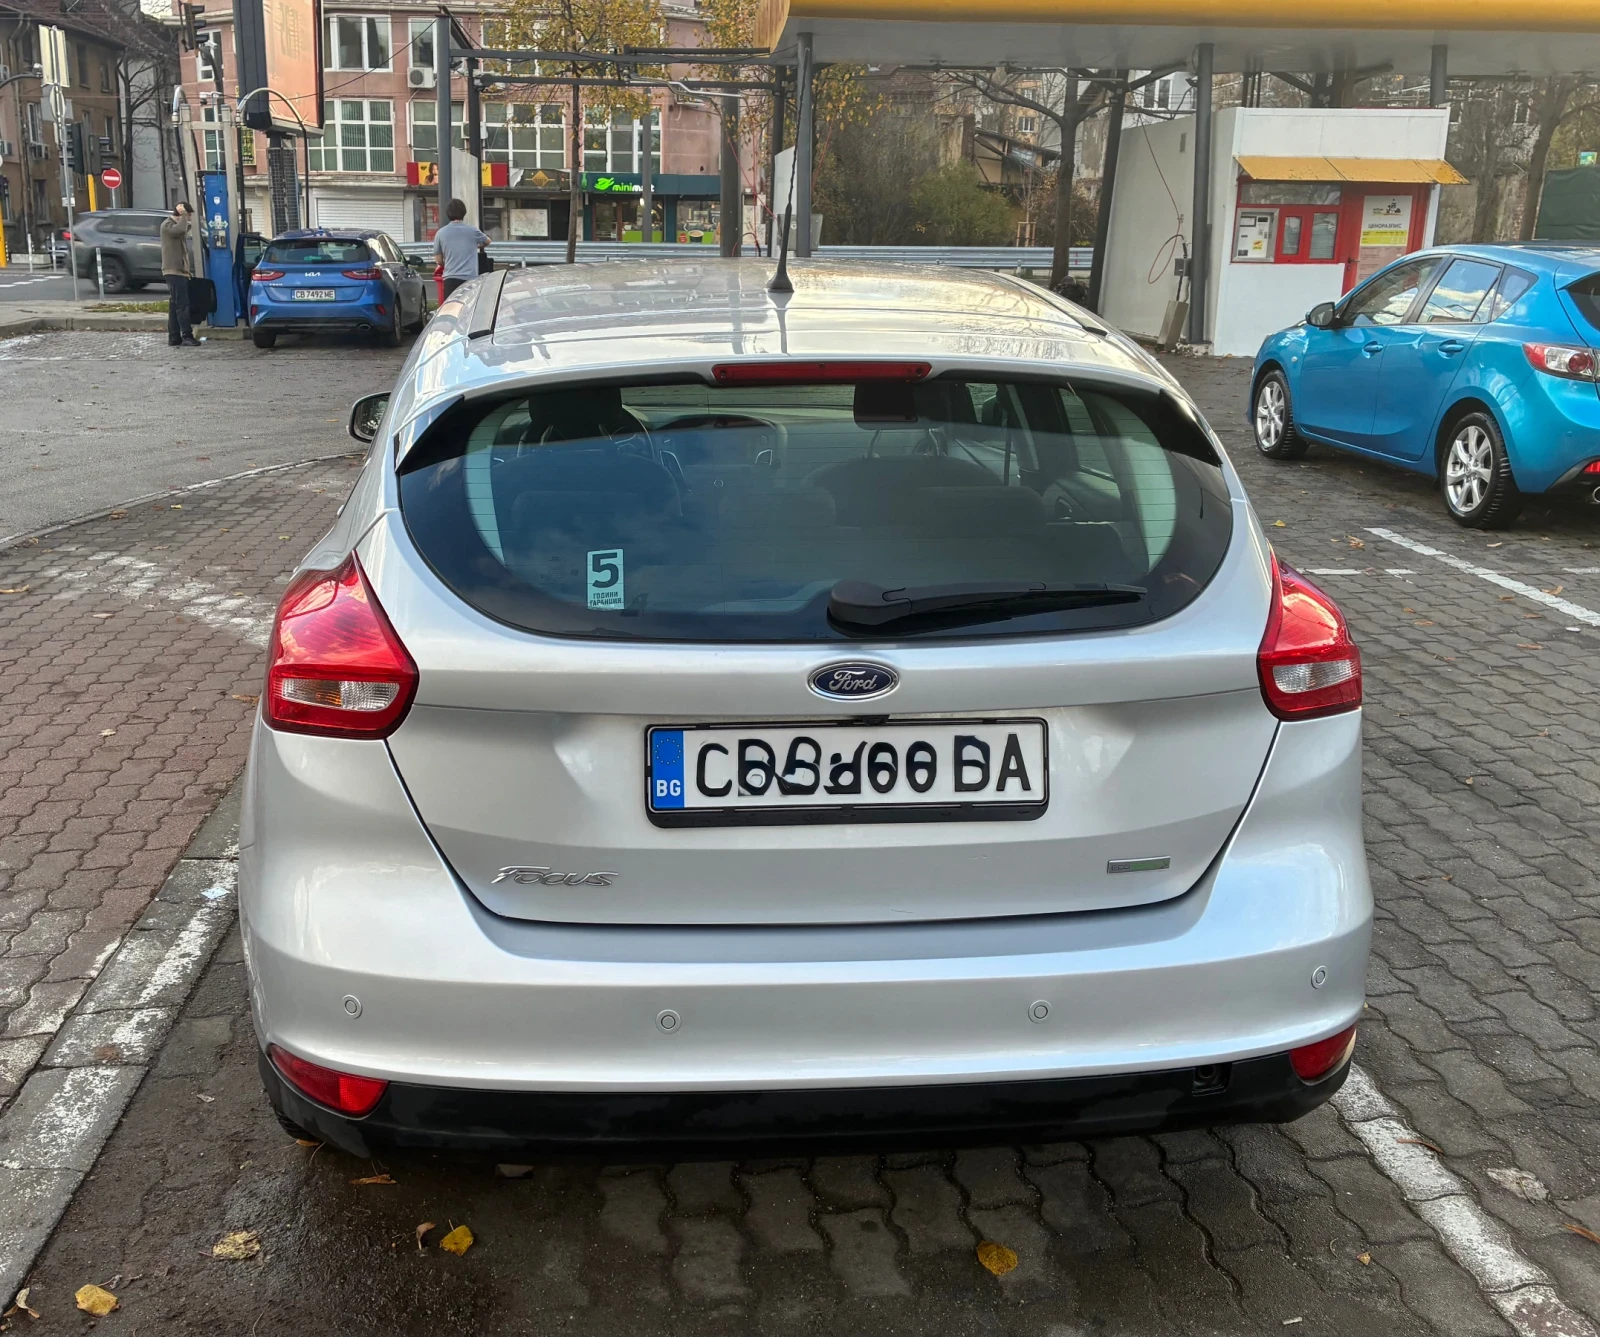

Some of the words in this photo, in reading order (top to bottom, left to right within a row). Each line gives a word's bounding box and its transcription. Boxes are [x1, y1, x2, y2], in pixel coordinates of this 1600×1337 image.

[306, 290, 323, 298] 7492
[592, 552, 619, 588] 5
[590, 598, 621, 606] ГАРАНЦИЯ
[828, 670, 878, 691] Ford
[656, 779, 681, 797] BG
